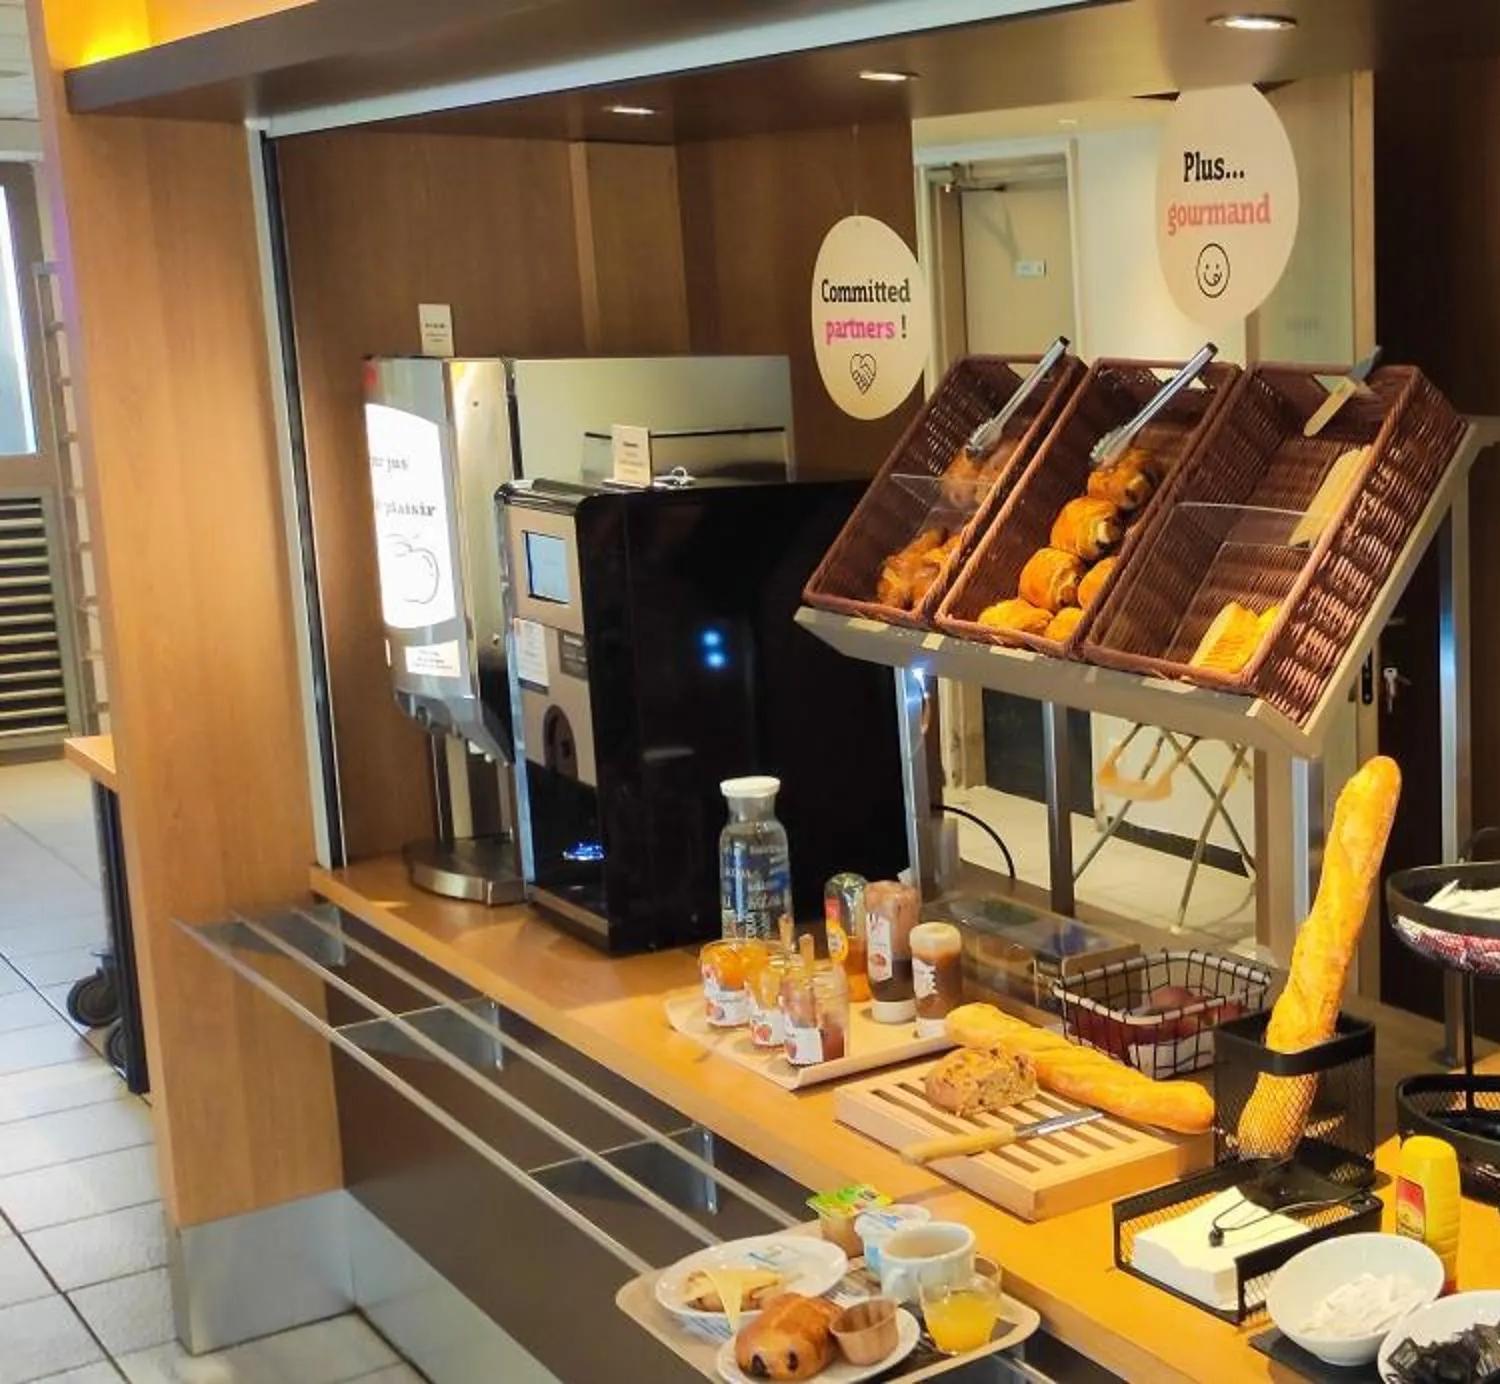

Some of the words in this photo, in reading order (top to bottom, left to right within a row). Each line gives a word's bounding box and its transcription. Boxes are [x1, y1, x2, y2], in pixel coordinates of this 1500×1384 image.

[1183, 150, 1245, 182] Plus...
[1167, 192, 1271, 236] gourmand
[821, 278, 911, 303] Committed
[826, 319, 896, 345] partners
[901, 314, 908, 339] !
